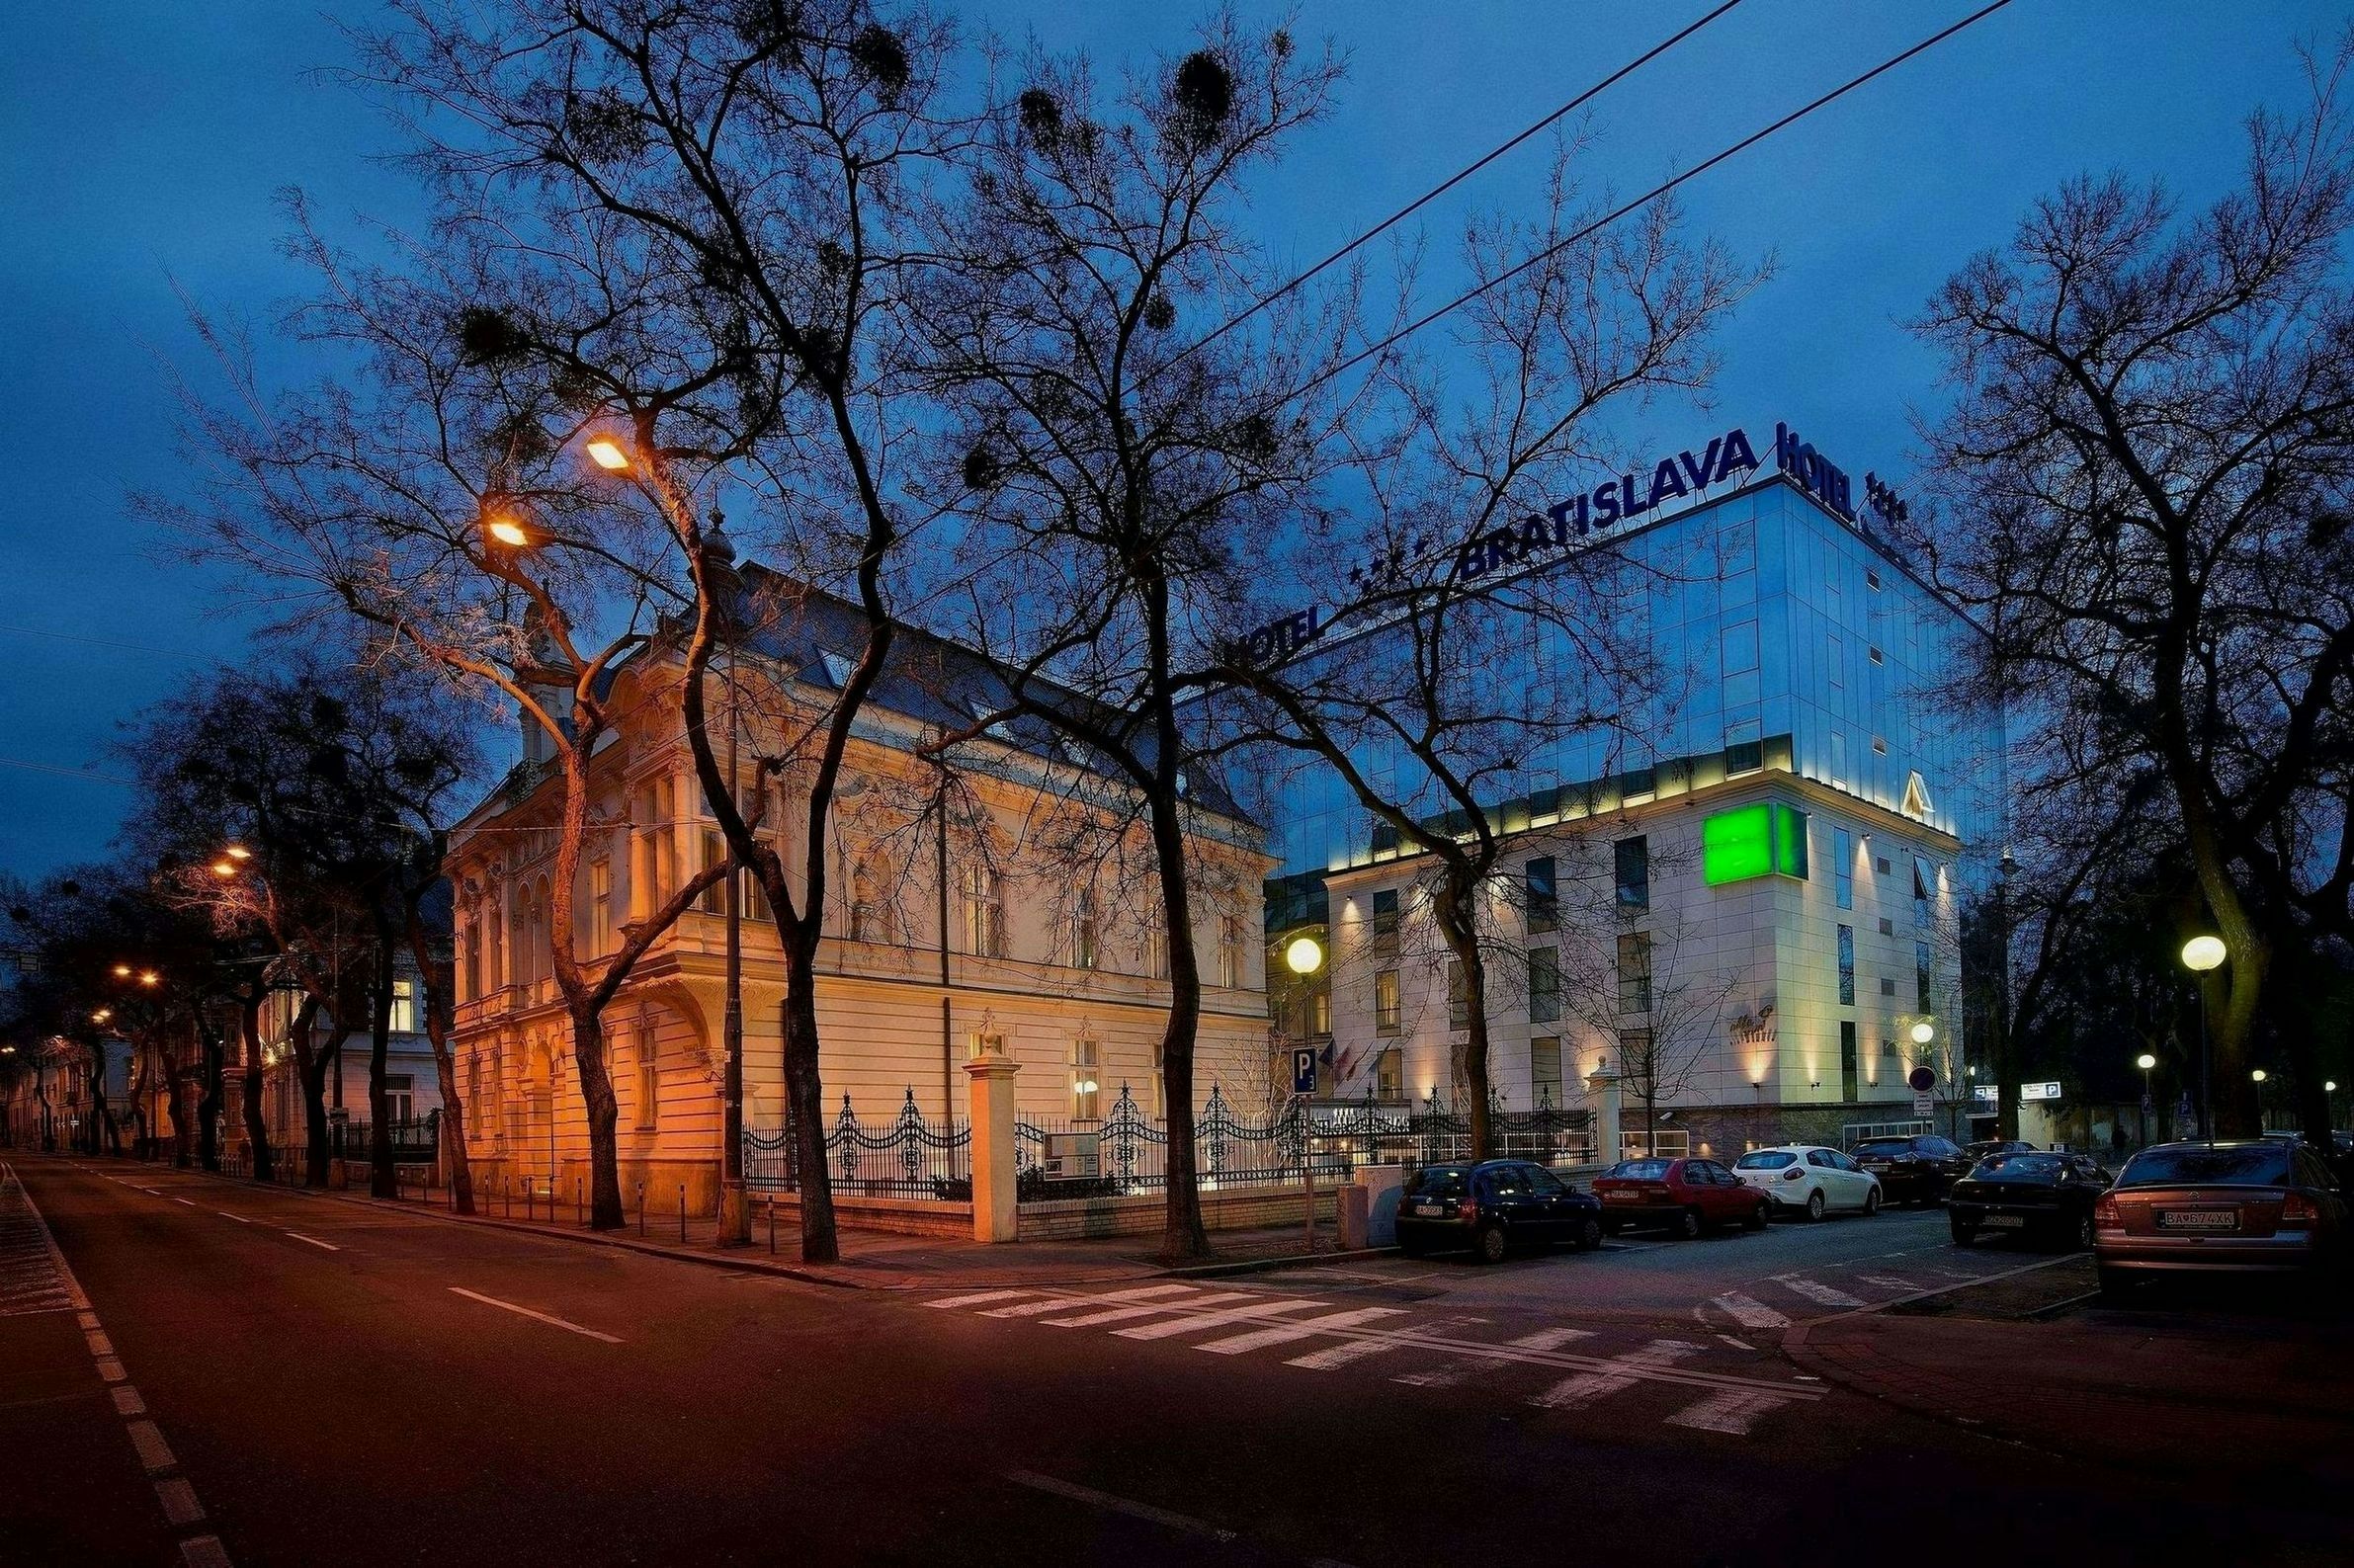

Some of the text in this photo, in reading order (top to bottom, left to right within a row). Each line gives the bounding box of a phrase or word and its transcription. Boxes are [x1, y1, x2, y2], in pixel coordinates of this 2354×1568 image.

[1776, 422, 1854, 523] HOTEL
[1459, 428, 1760, 582] BRATISLAVA
[1299, 1053, 1310, 1080] P
[2049, 1085, 2057, 1095] P
